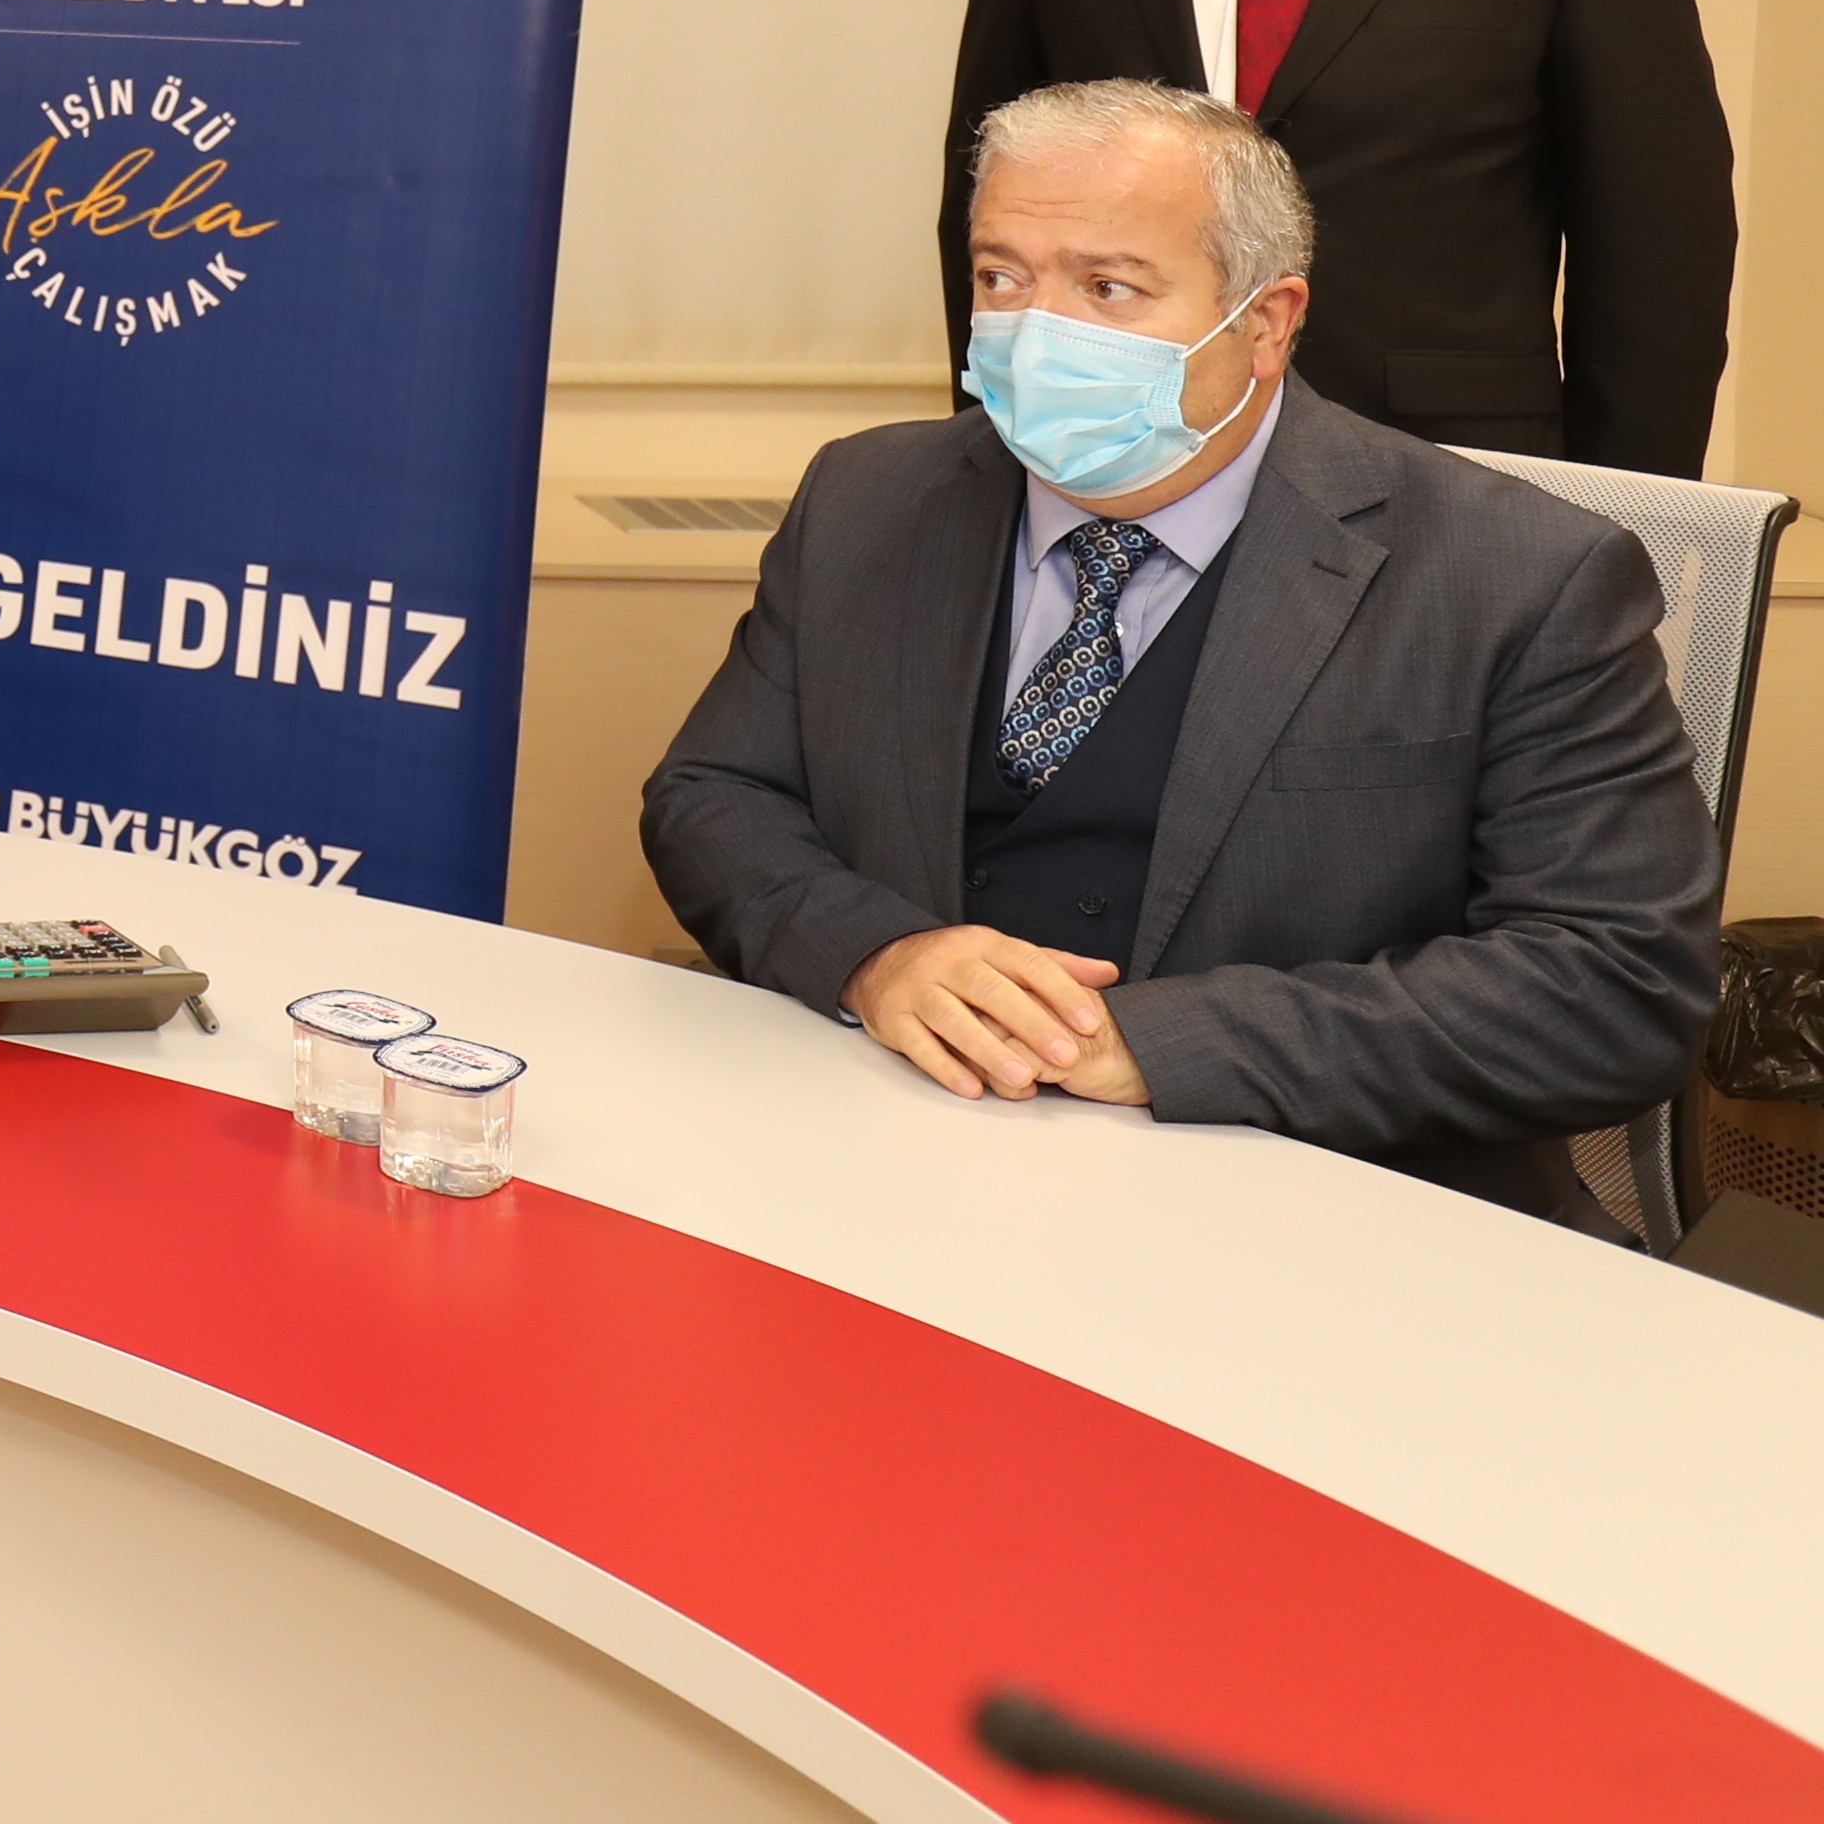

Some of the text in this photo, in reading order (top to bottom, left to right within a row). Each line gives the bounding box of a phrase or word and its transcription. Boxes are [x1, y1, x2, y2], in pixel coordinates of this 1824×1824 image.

[41, 76, 237, 152] İŞİN ÖZÜ
[5, 253, 248, 346] ÇALIŞMAK
[8, 789, 363, 895] BÜYÜKGÖZ
